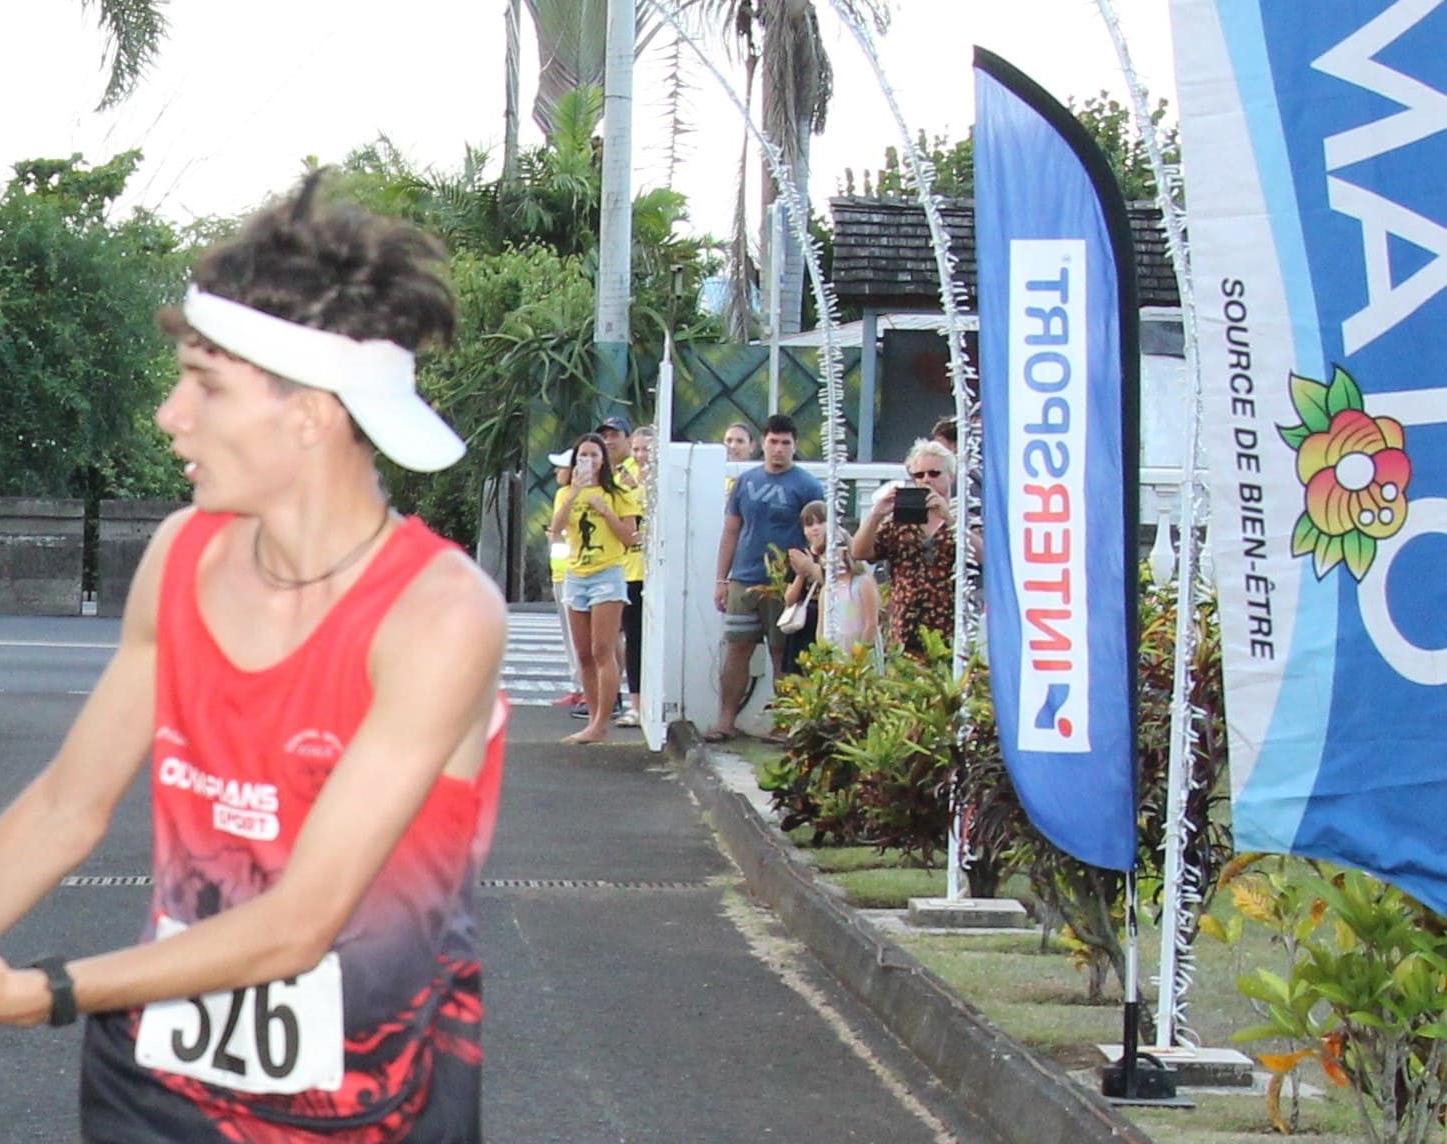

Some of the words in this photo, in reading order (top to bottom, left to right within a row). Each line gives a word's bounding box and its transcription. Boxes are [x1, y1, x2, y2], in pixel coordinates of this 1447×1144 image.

[1221, 278, 1256, 418] SOURCE
[1233, 427, 1261, 475] DE
[1239, 483, 1276, 661] BIEN-ÊTRE
